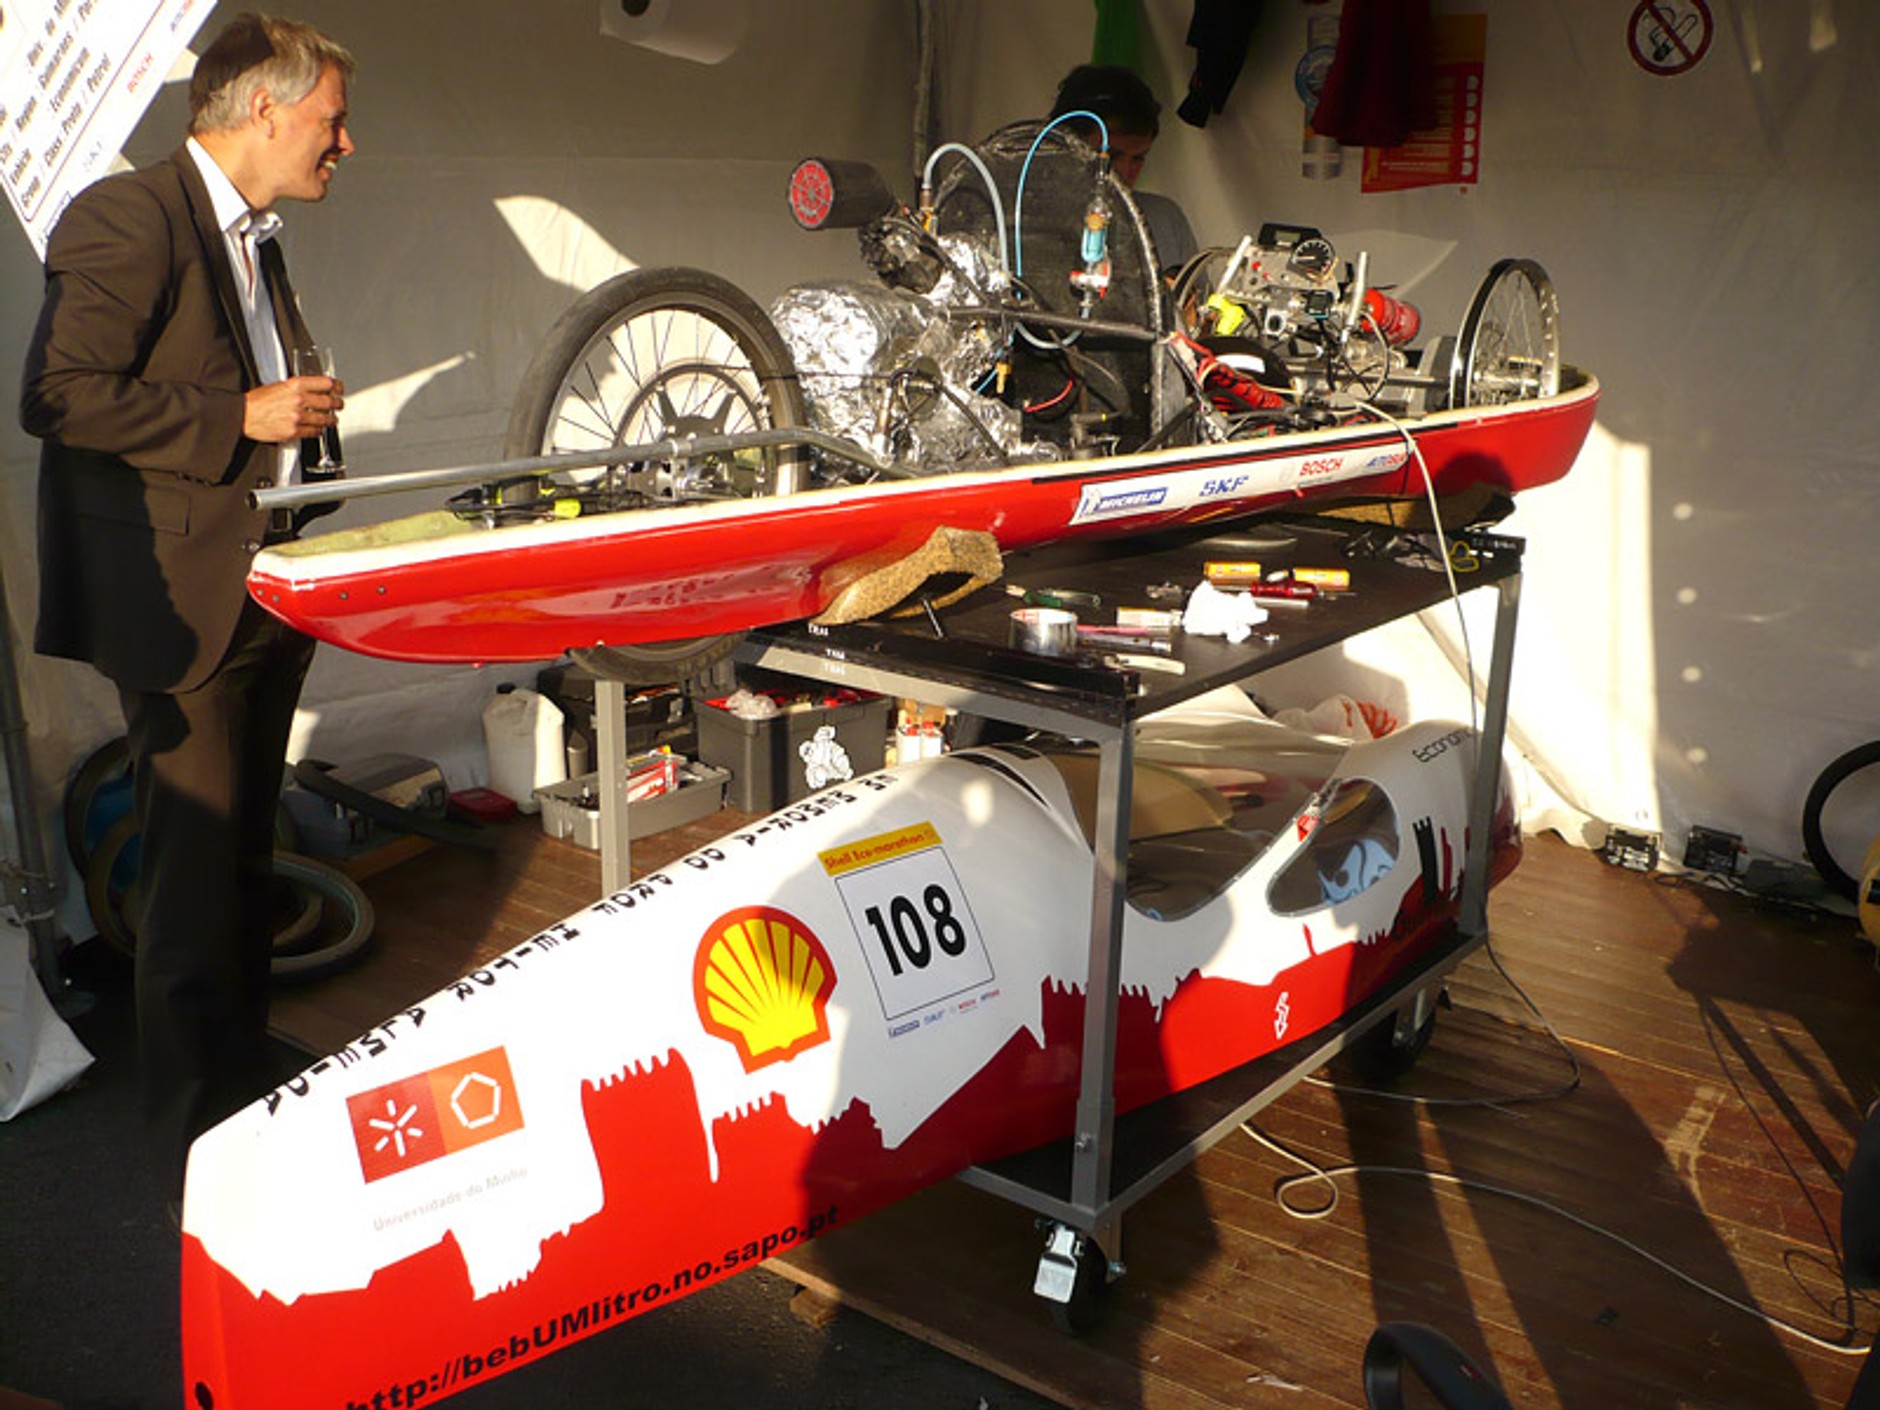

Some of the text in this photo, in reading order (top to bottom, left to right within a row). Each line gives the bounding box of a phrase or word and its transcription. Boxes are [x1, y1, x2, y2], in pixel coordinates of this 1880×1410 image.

[86, 52, 111, 94] Petrol
[1199, 475, 1249, 498] SKF
[1299, 457, 1344, 477] BOSCH
[684, 847, 726, 870] DO
[824, 851, 852, 869] Shell
[592, 873, 674, 915] PROF
[864, 884, 967, 976] 108
[448, 923, 581, 1002] HEITOR
[261, 1006, 427, 1118] ALMEIDA
